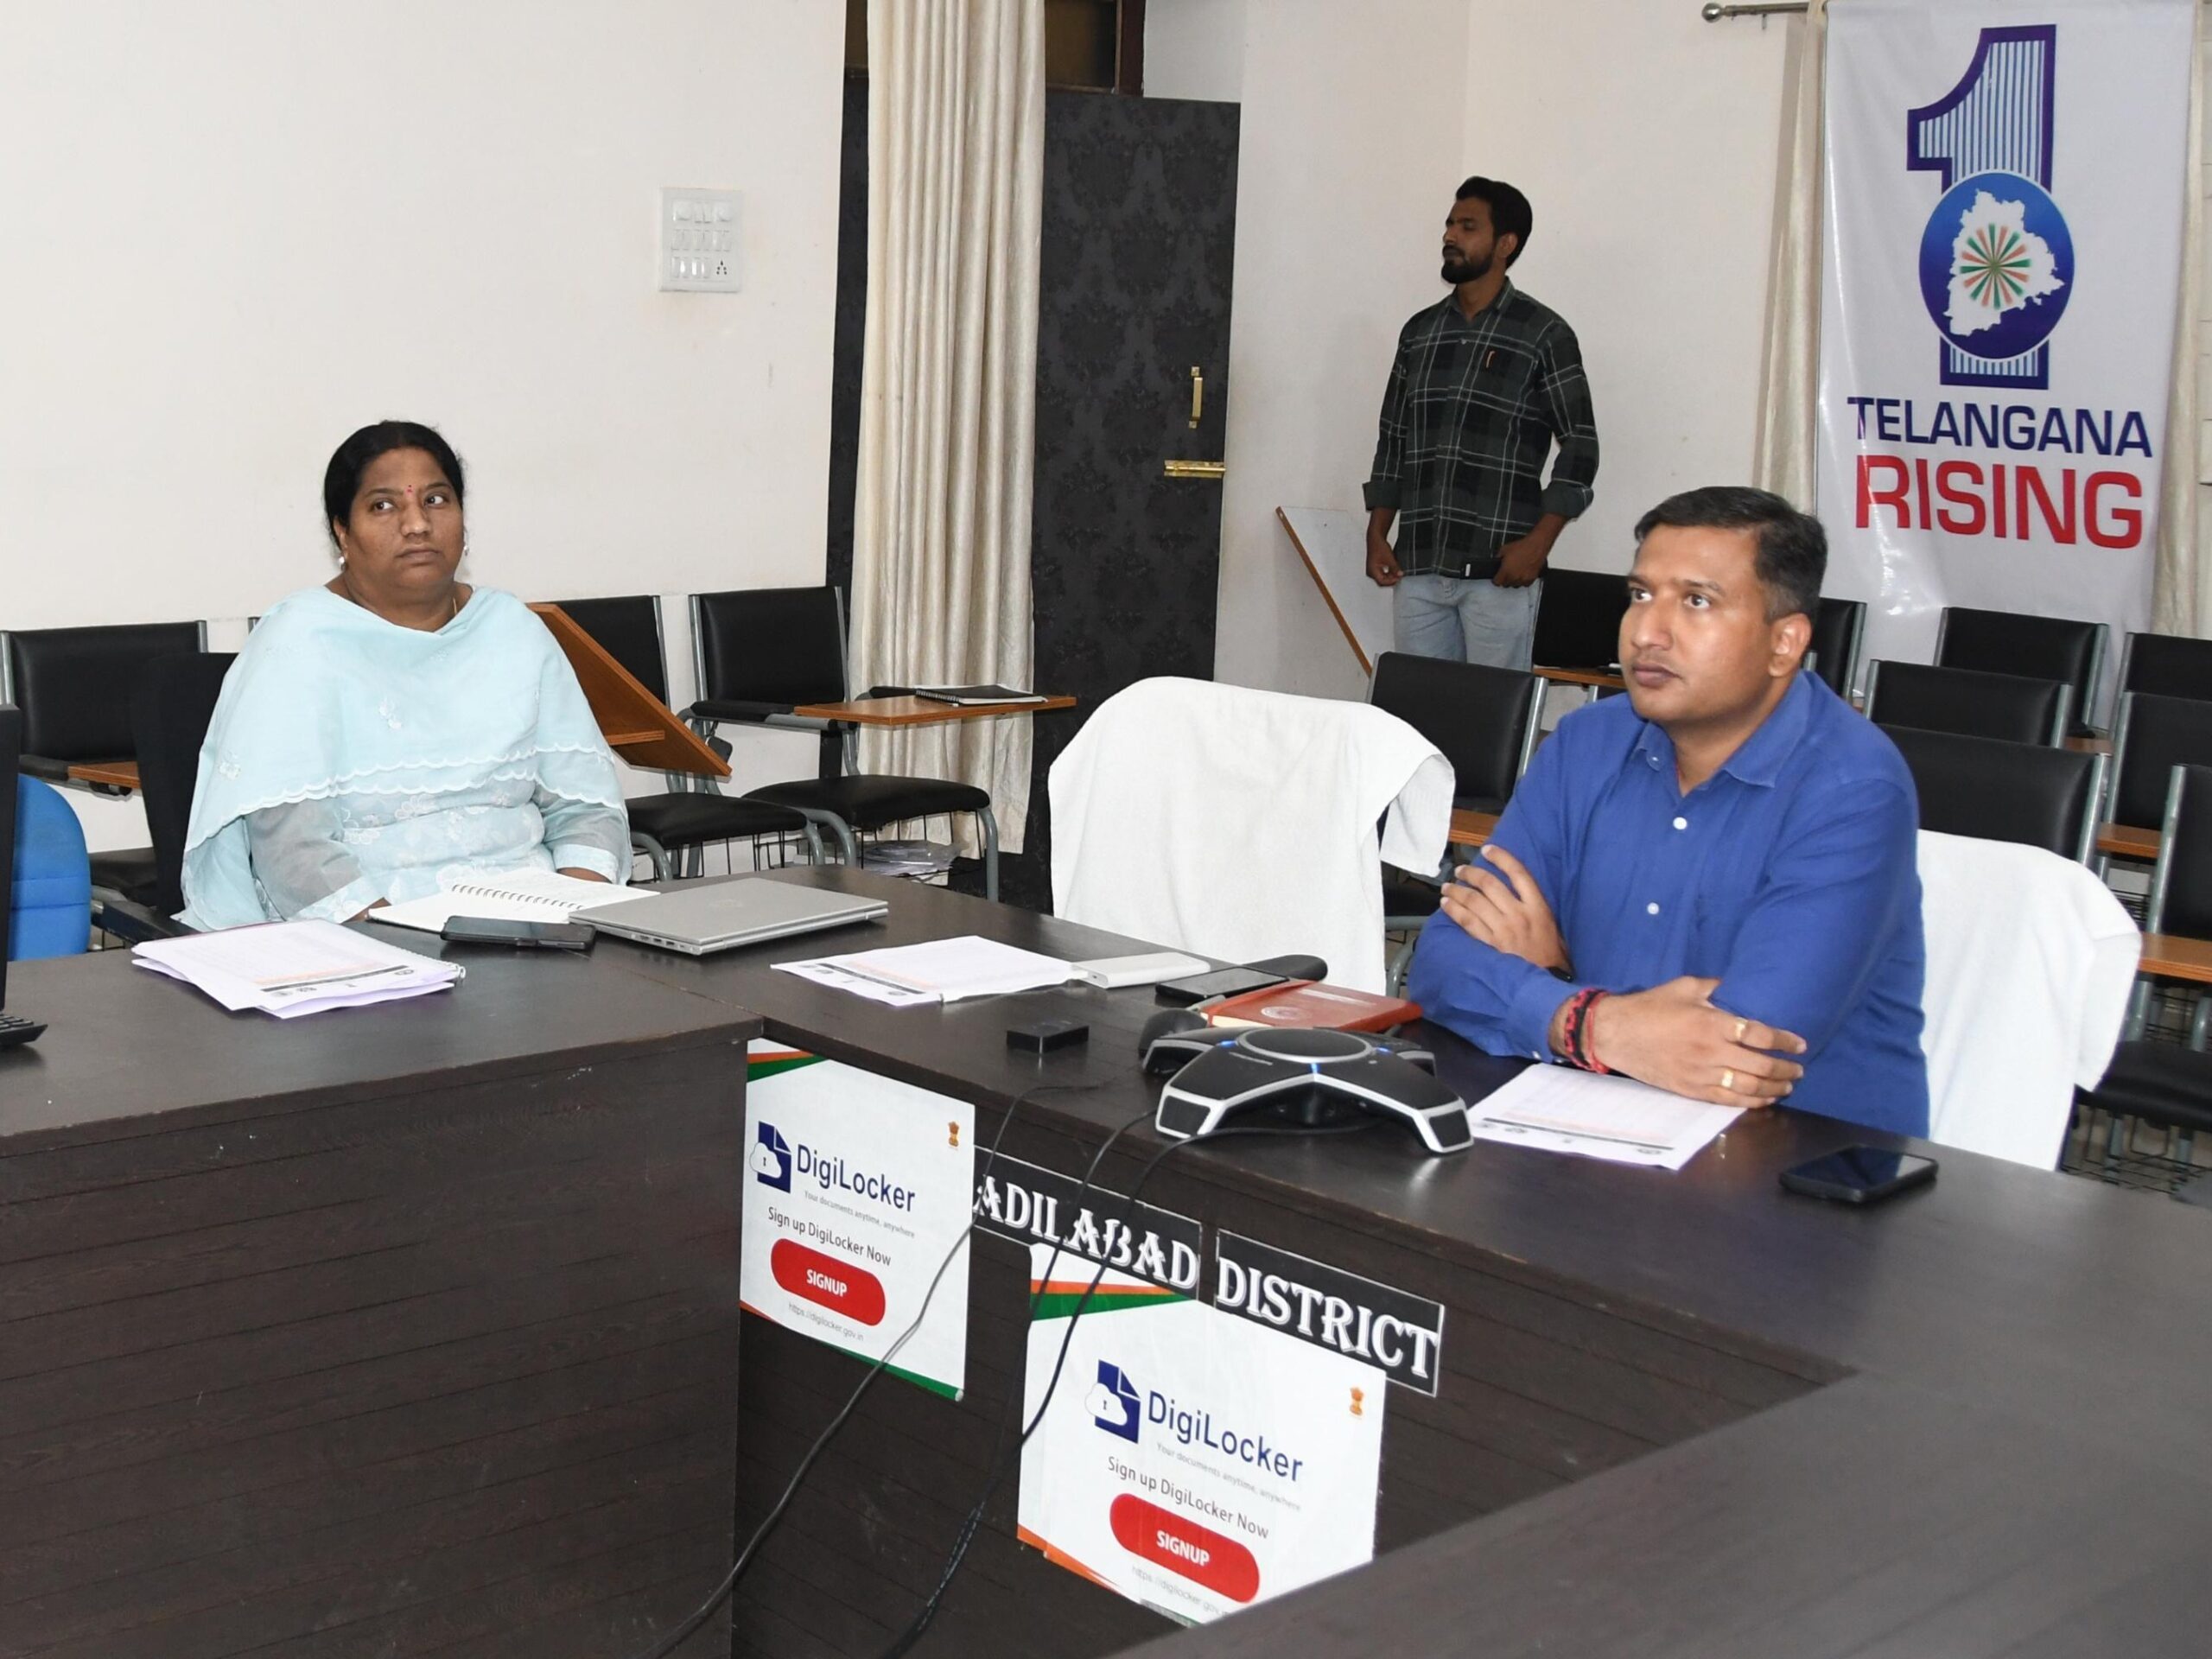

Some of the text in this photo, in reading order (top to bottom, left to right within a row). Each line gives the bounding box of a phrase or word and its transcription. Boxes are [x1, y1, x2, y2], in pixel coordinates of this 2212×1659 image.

[1847, 397, 2152, 458] TELANGANA
[1855, 454, 2143, 549] RISING
[797, 1143, 916, 1212] DigiLocker
[768, 1206, 892, 1266] Sign up DigiLocker Now
[806, 1269, 848, 1297] SIGNUP
[972, 1173, 1439, 1379] ADILABAD DISTRICT
[1148, 1390, 1303, 1481] DigiLocker
[1108, 1456, 1269, 1540] Sign up DigiLocker Now
[1156, 1529, 1211, 1567] SIGNUP
